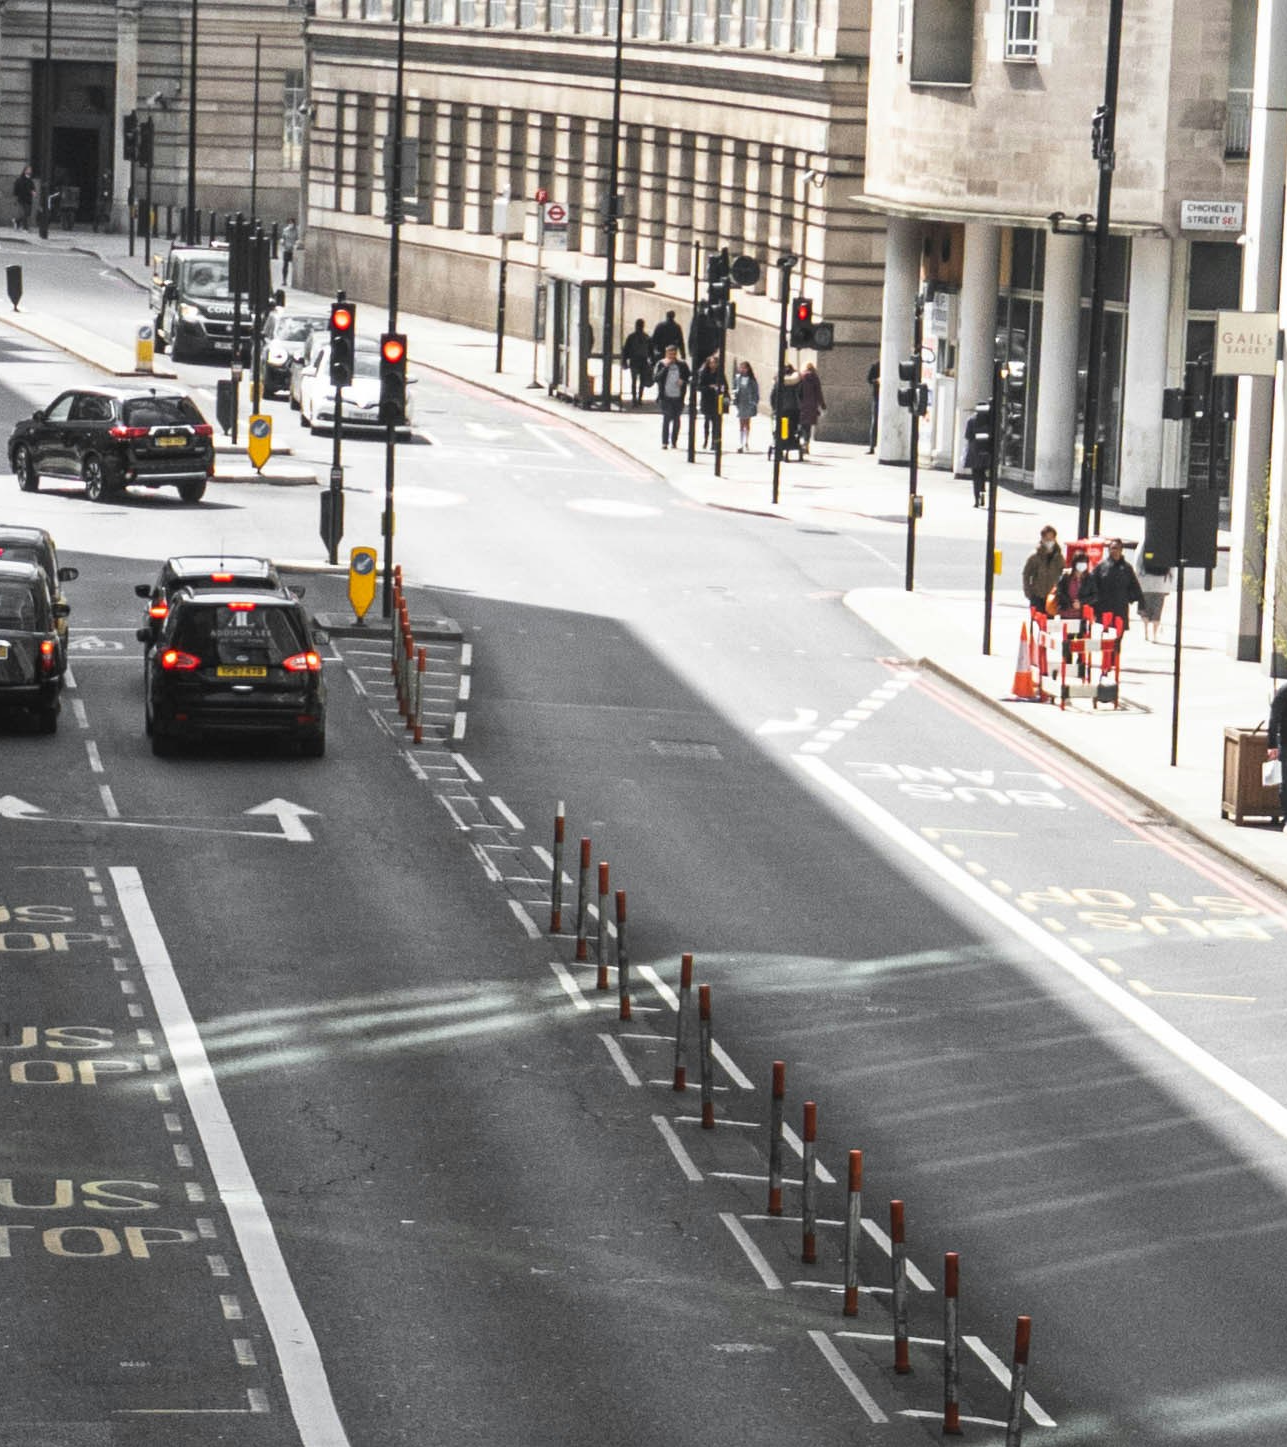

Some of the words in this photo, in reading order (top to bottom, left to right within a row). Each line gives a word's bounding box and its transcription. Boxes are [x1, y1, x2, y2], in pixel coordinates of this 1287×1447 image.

[1187, 204, 1236, 214] CHICHELEY
[1186, 215, 1219, 225] STREET
[1223, 332, 1274, 346] GAIL's
